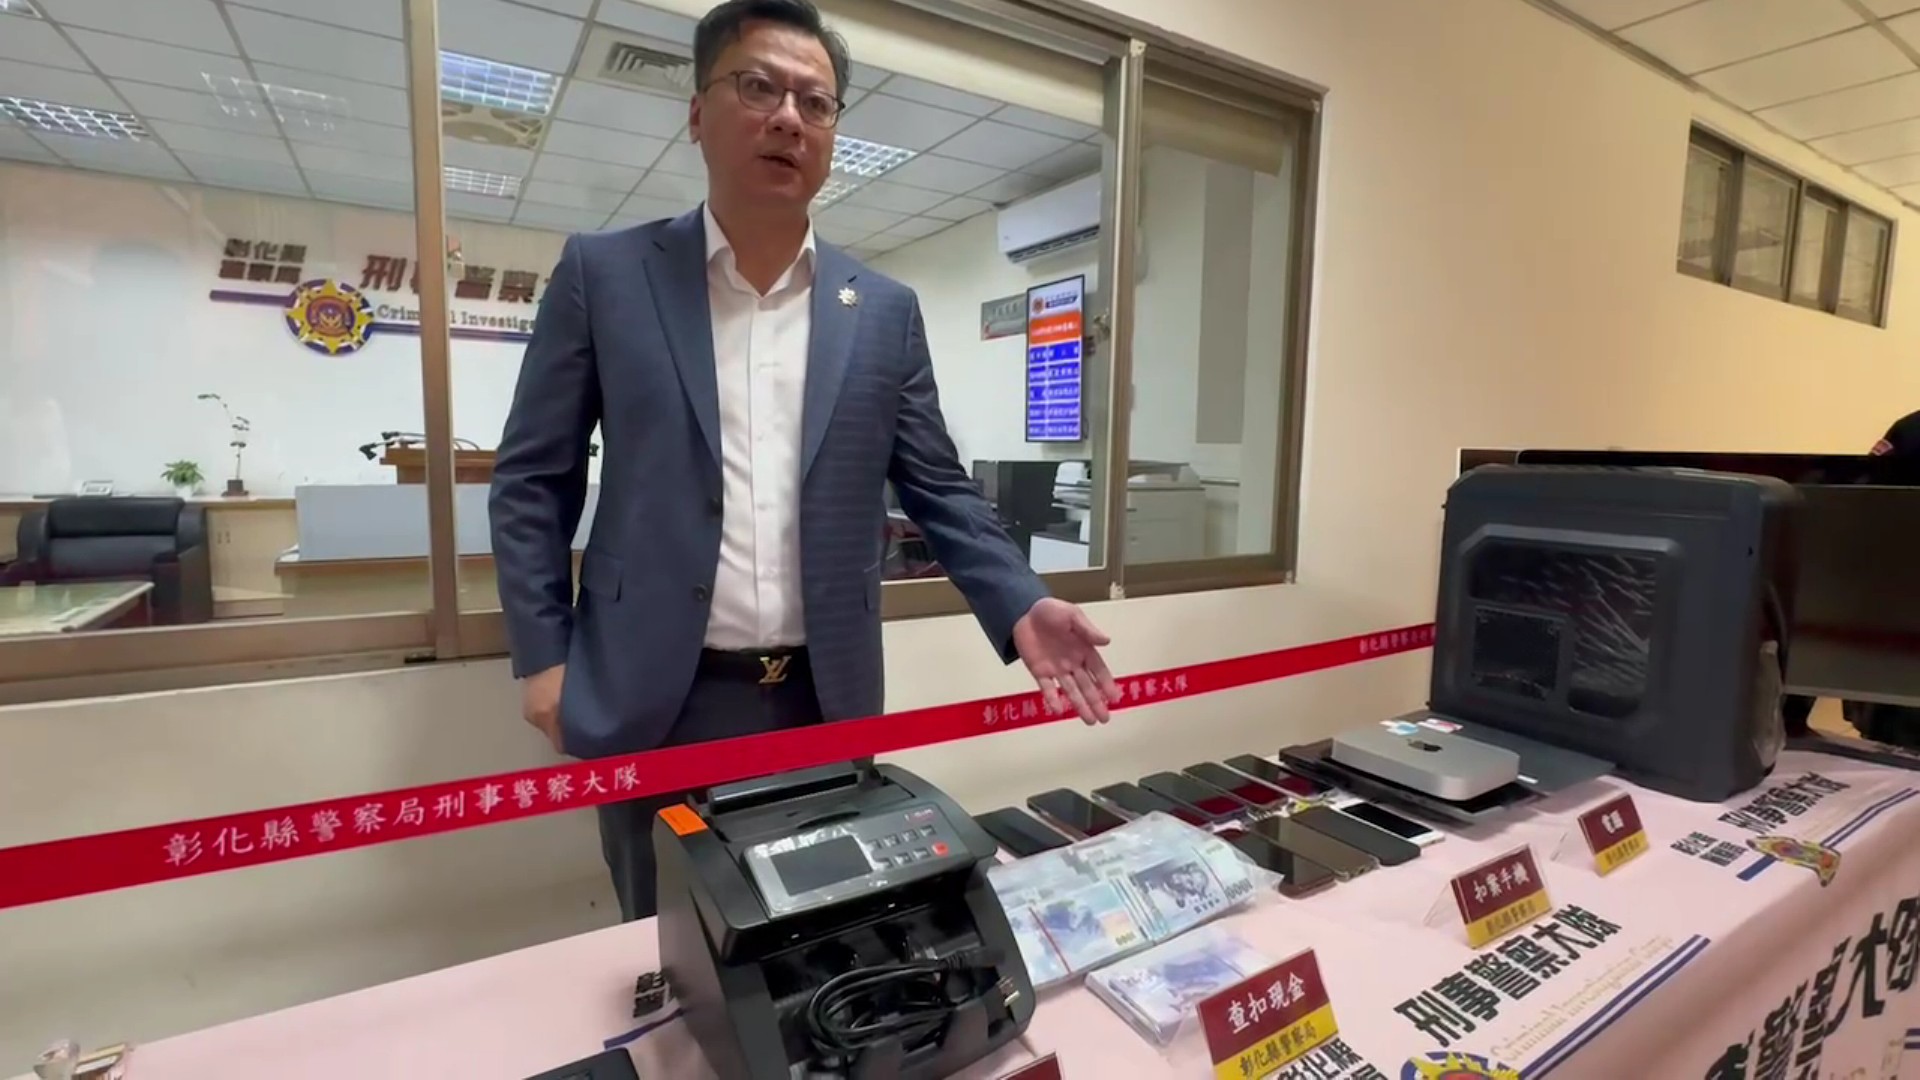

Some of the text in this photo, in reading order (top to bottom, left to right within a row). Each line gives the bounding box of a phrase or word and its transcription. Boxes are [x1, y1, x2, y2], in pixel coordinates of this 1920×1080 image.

[377, 304, 456, 325] Criml
[164, 763, 642, 868] 彰化縣警察局刑事警察大隊
[1227, 971, 1306, 1035] 查扣現金
[1393, 903, 1623, 1049] 刑事警察大隊
